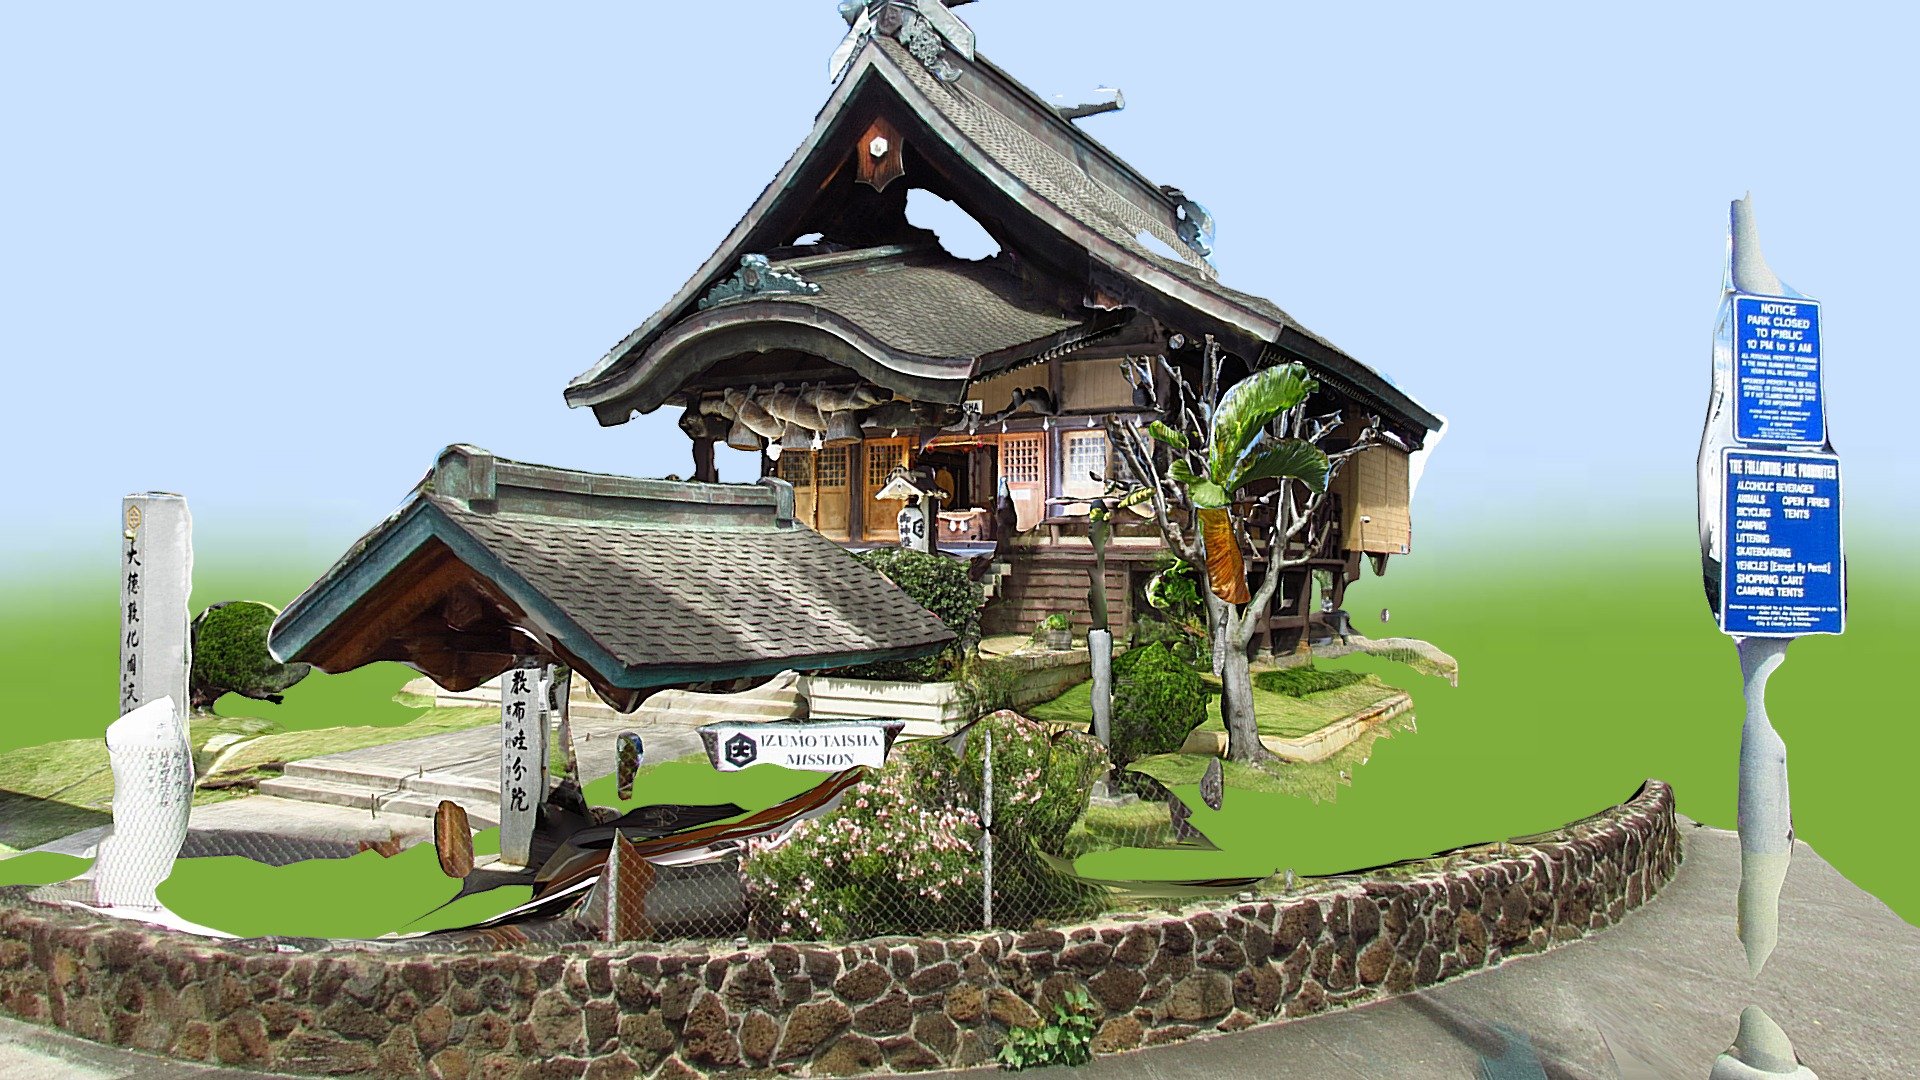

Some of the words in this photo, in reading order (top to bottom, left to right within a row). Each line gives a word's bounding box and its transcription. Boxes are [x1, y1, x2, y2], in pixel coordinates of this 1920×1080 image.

[1761, 303, 1797, 316] NOTICE
[1747, 315, 1771, 326] PARK
[1773, 317, 1810, 329] CLOSED
[1755, 327, 1768, 338] TO
[1771, 329, 1803, 340] PUBLIC
[1746, 339, 1757, 349] 10
[1760, 340, 1774, 350] PM
[1797, 343, 1812, 353] AM
[1736, 481, 1775, 492] ALCOHOLIC
[1782, 496, 1805, 506] OPEN
[1783, 508, 1810, 519] TENTS
[1736, 573, 1779, 585] SHOPPING
[1781, 575, 1804, 585] CART
[1736, 586, 1774, 597] CAMPING
[1776, 587, 1804, 597] TENTS
[761, 734, 817, 748] IZUMO
[820, 734, 879, 748] TAISHA
[786, 753, 854, 766] MISSION
